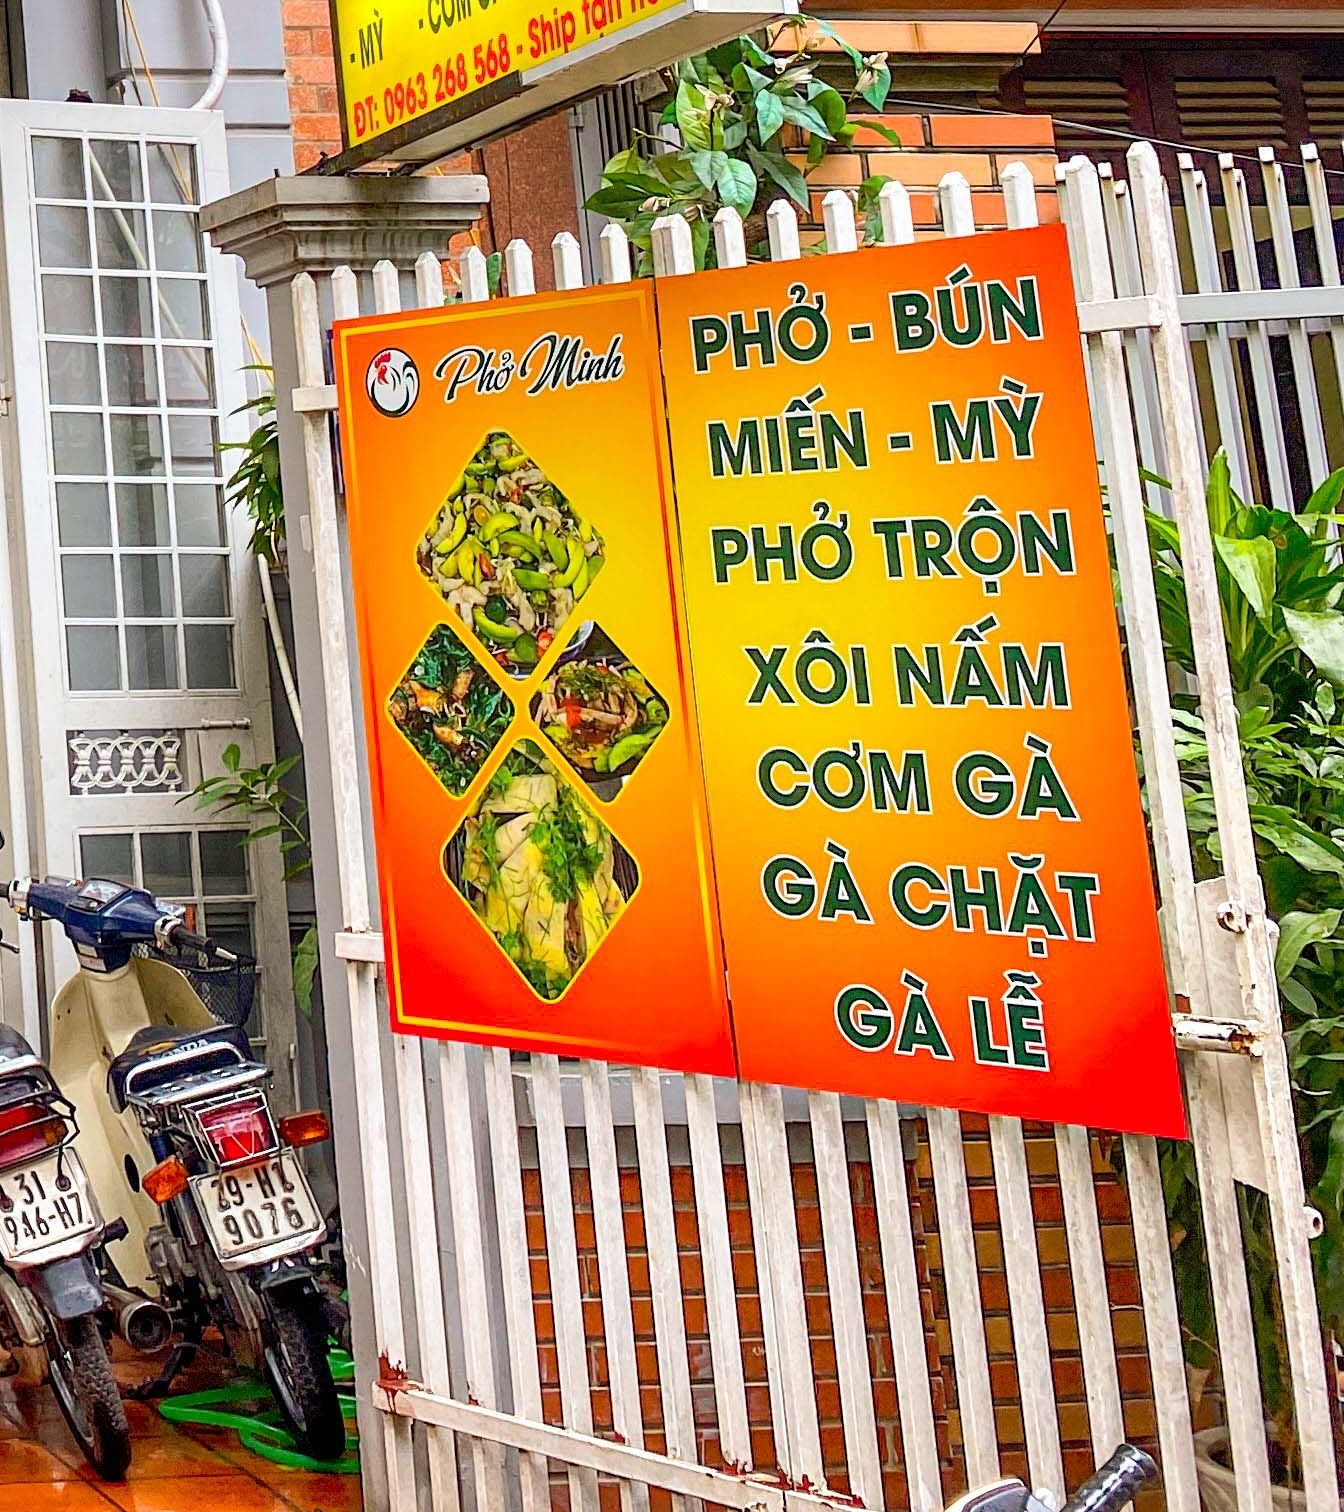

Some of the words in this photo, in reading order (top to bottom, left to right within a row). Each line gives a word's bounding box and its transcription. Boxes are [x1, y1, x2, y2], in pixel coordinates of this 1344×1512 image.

[353, 95, 380, 138] ĐT:
[384, 72, 428, 125] 0963
[432, 53, 468, 104] 268
[473, 33, 511, 85] 568
[528, 7, 576, 59] Ship
[358, 7, 384, 70] MỲ
[690, 283, 830, 376] PHỞ
[889, 264, 1047, 356] BÚN
[434, 348, 516, 404] Phở
[518, 331, 627, 399] Minh
[707, 387, 869, 480] MIẾN
[930, 377, 1047, 466] MỲ
[710, 502, 853, 587] PHỞ
[874, 496, 1077, 598] TRỘN
[745, 628, 869, 707] XÔI
[893, 613, 1073, 711] NẤM
[757, 739, 930, 815] CƠM
[954, 735, 1082, 822] GÀ
[762, 840, 873, 924] GÀ
[889, 851, 1101, 959] CHẶT
[834, 970, 957, 1063] GÀ
[3, 1192, 83, 1246] 946-H7
[14, 1170, 46, 1205] 31
[222, 1197, 304, 1246] 9076
